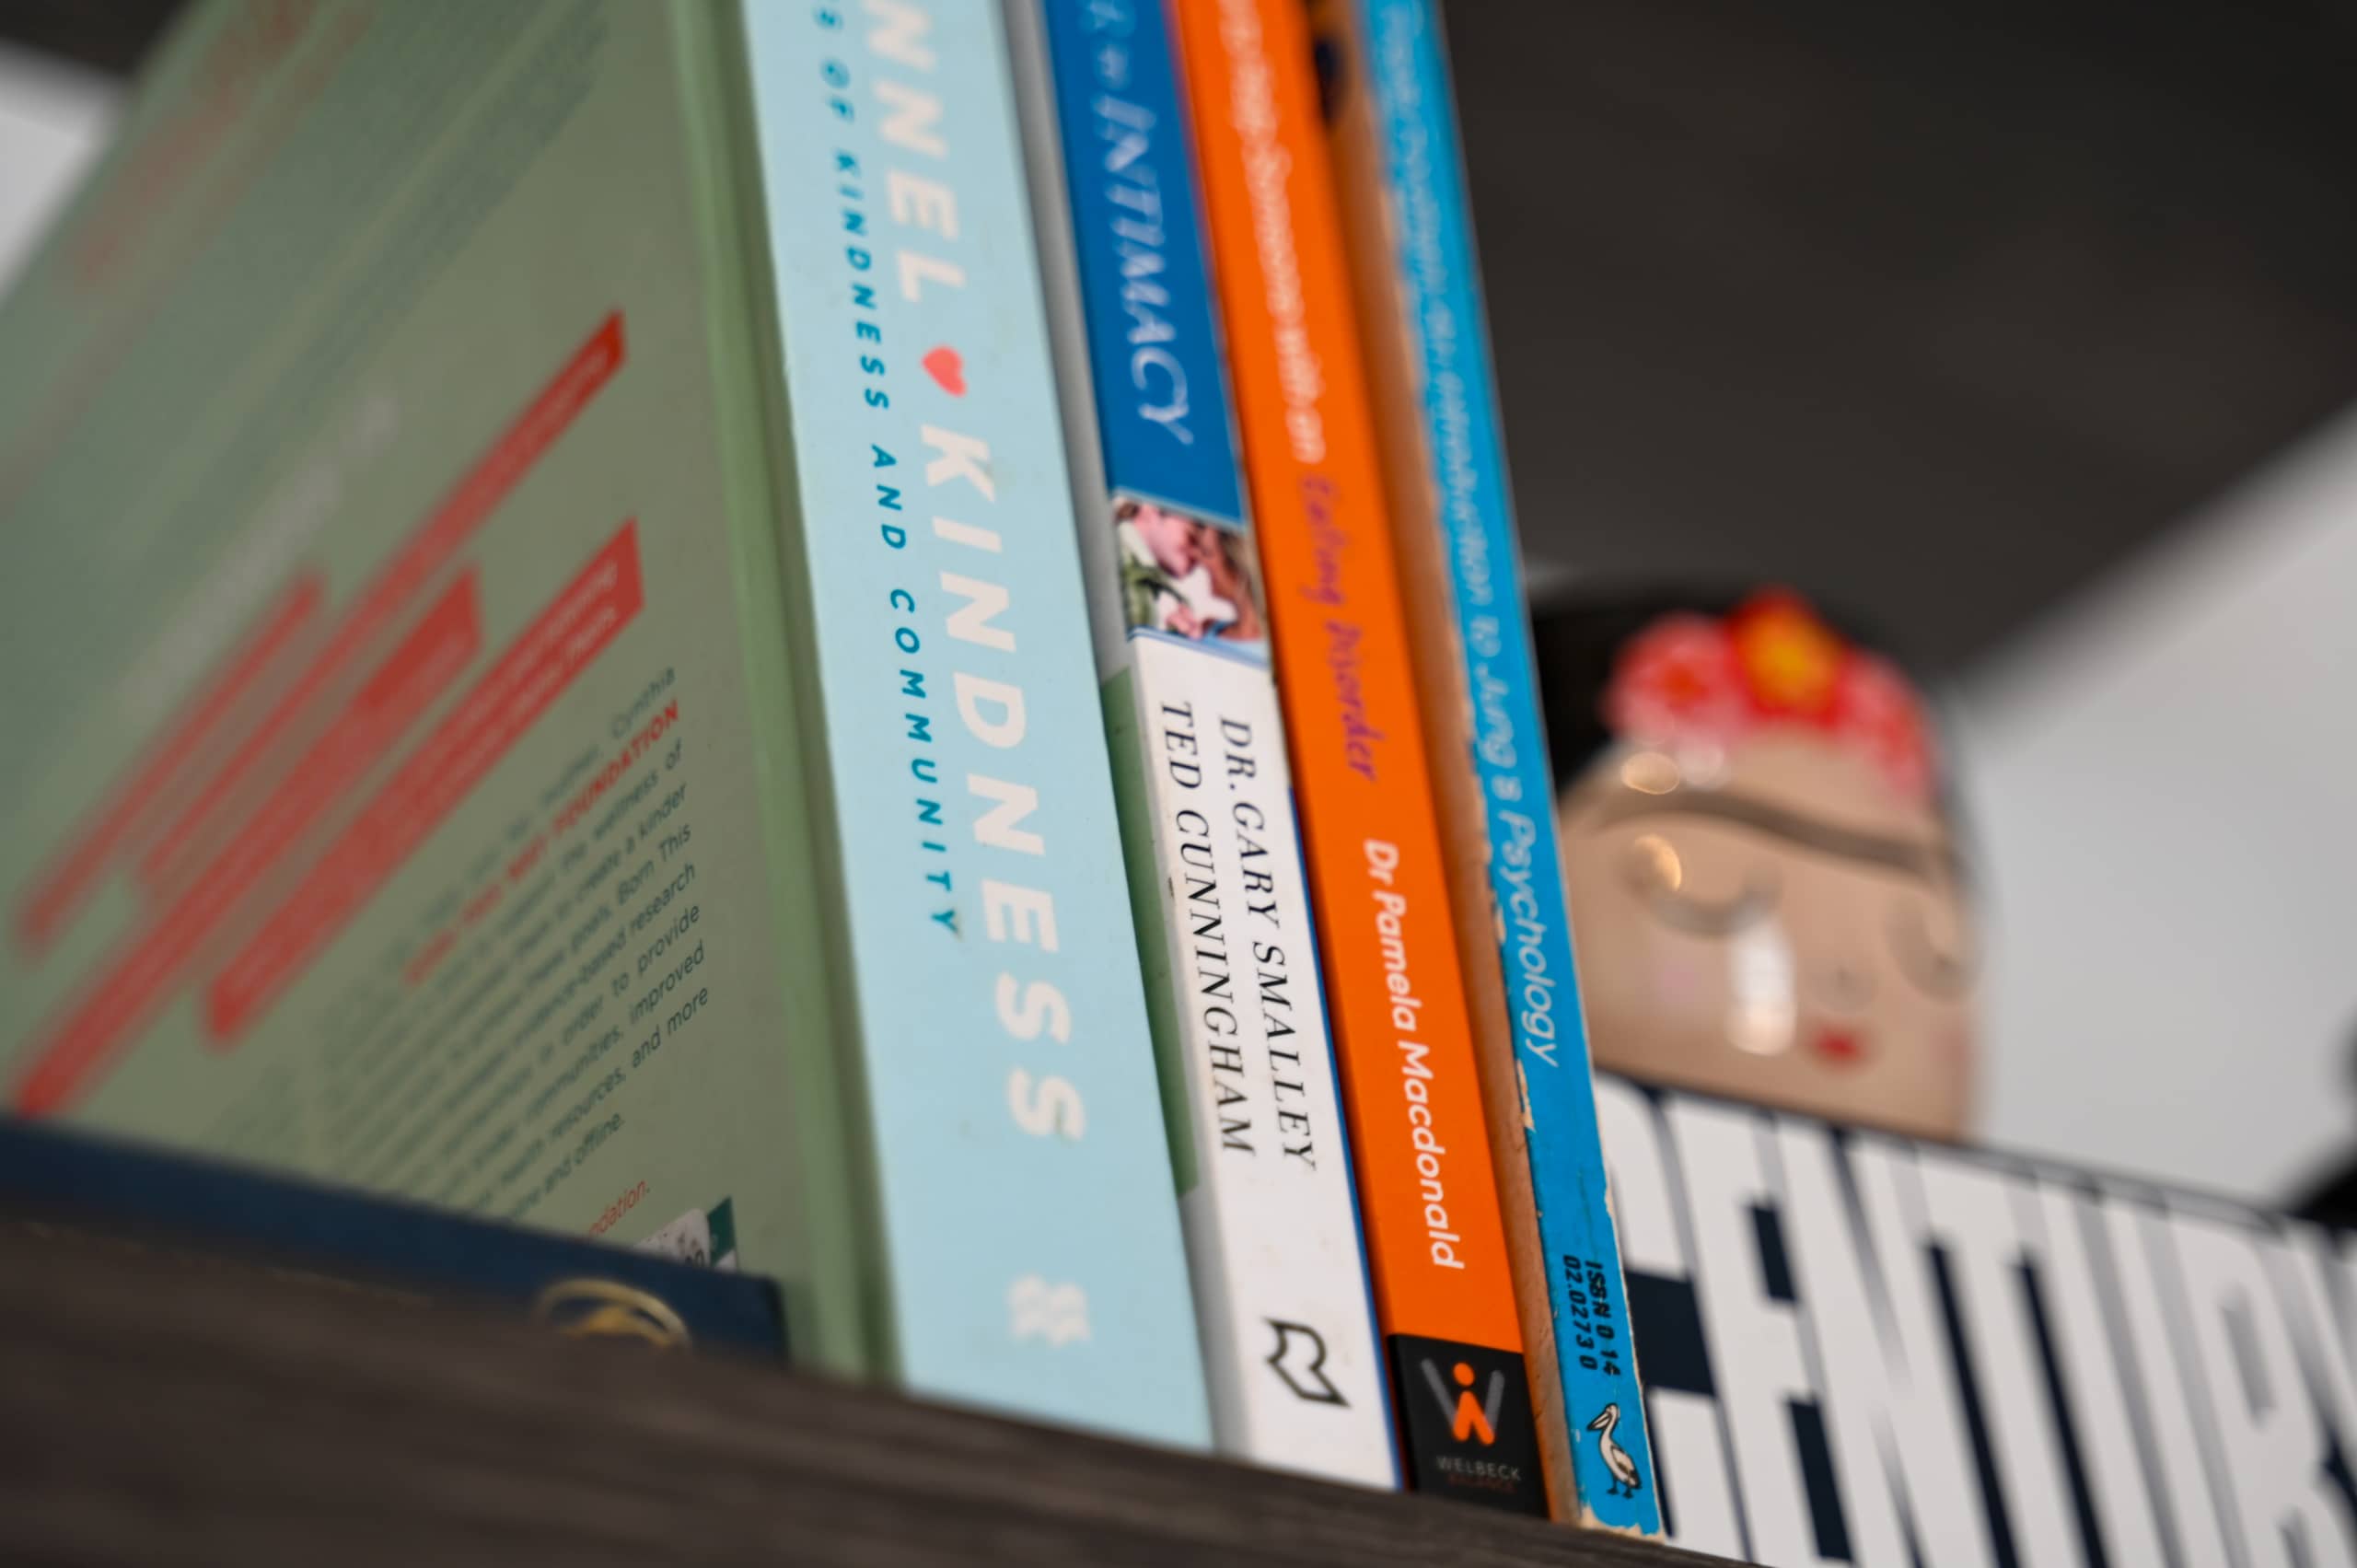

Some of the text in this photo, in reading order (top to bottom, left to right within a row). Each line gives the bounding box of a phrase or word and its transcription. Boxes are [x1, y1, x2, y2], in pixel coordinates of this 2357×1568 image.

[819, 55, 855, 123] OF
[832, 147, 889, 410] KINDNESS
[1094, 95, 1194, 445] INTIMACY
[871, 444, 906, 549] AND
[665, 738, 682, 770] of
[1324, 618, 1385, 782] Disorder
[551, 698, 679, 838] FOUNDATION
[639, 782, 687, 840] kinder
[890, 589, 960, 938] COMMUNITY
[921, 424, 1087, 1142] KINDNESS
[618, 859, 655, 906] Born
[658, 824, 691, 863] This
[631, 862, 695, 935] research
[612, 971, 630, 997] to
[637, 905, 700, 976] provide
[630, 938, 704, 1025] improved
[1161, 701, 1256, 1156] TED CUNNINGHAM
[1220, 715, 1317, 1171] DR. GARY SMALLEY
[1498, 809, 1559, 1068] Psychology
[632, 1024, 661, 1068] and
[668, 987, 708, 1036] more
[1363, 838, 1465, 1270] Dr Pamela Macdonald
[574, 1112, 626, 1166] offline.
[1585, 1260, 1613, 1319] ISBN
[1600, 1350, 1621, 1376] 14
[1435, 1455, 1522, 1481] WELBECK
